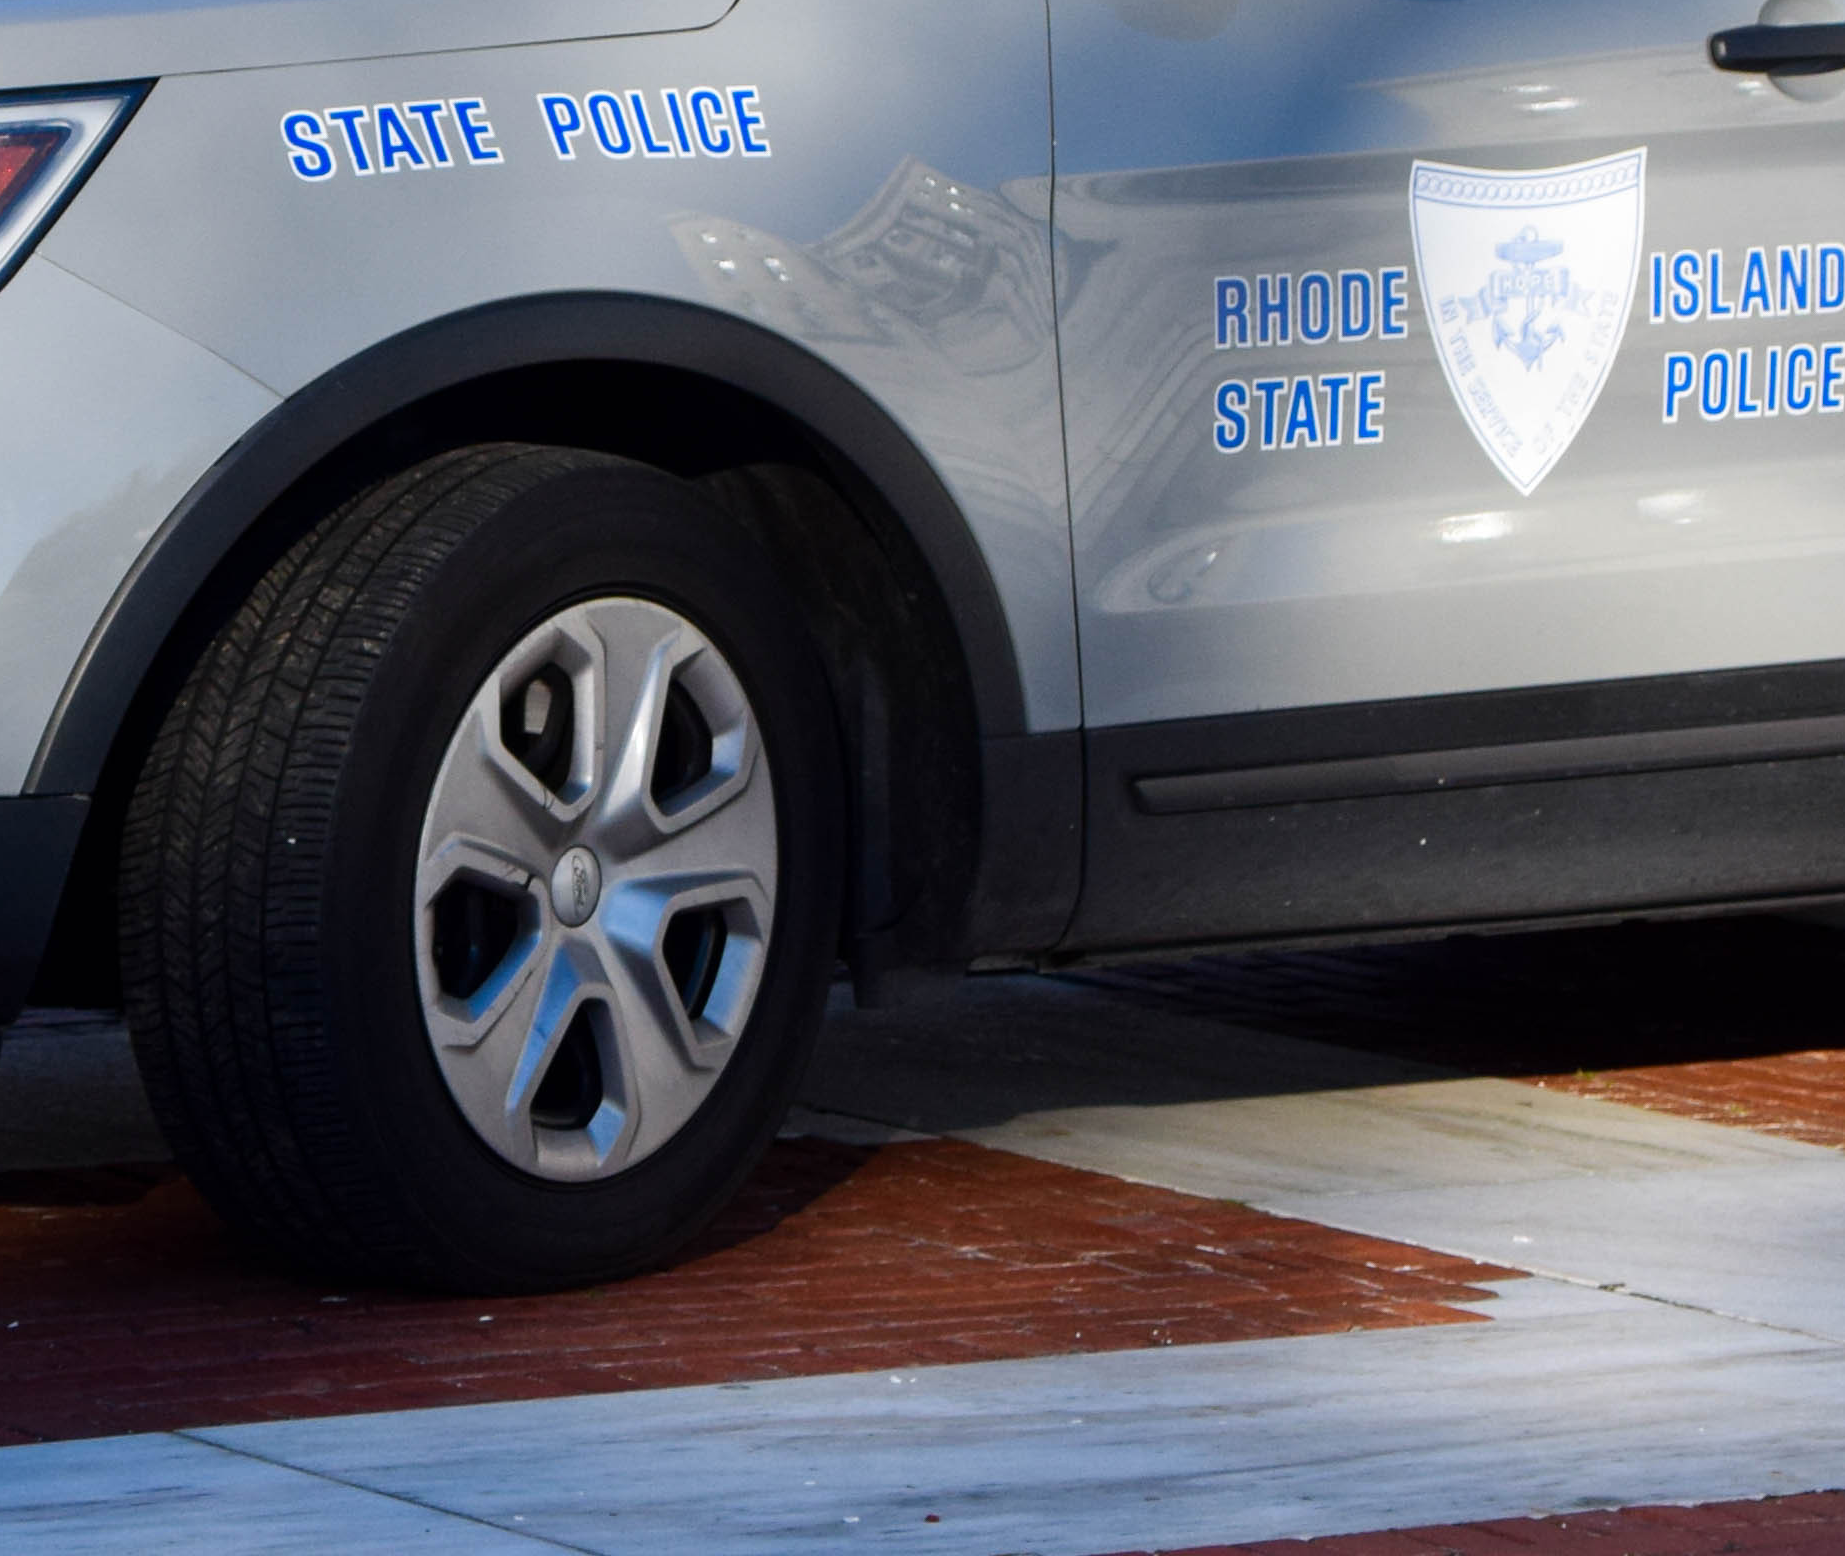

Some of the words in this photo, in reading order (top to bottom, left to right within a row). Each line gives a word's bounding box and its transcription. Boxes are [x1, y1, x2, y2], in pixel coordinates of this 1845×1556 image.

[280, 97, 505, 183] STATE
[536, 84, 772, 161] POLICE
[1214, 266, 1408, 349] RHODE
[1213, 369, 1385, 454] STATE
